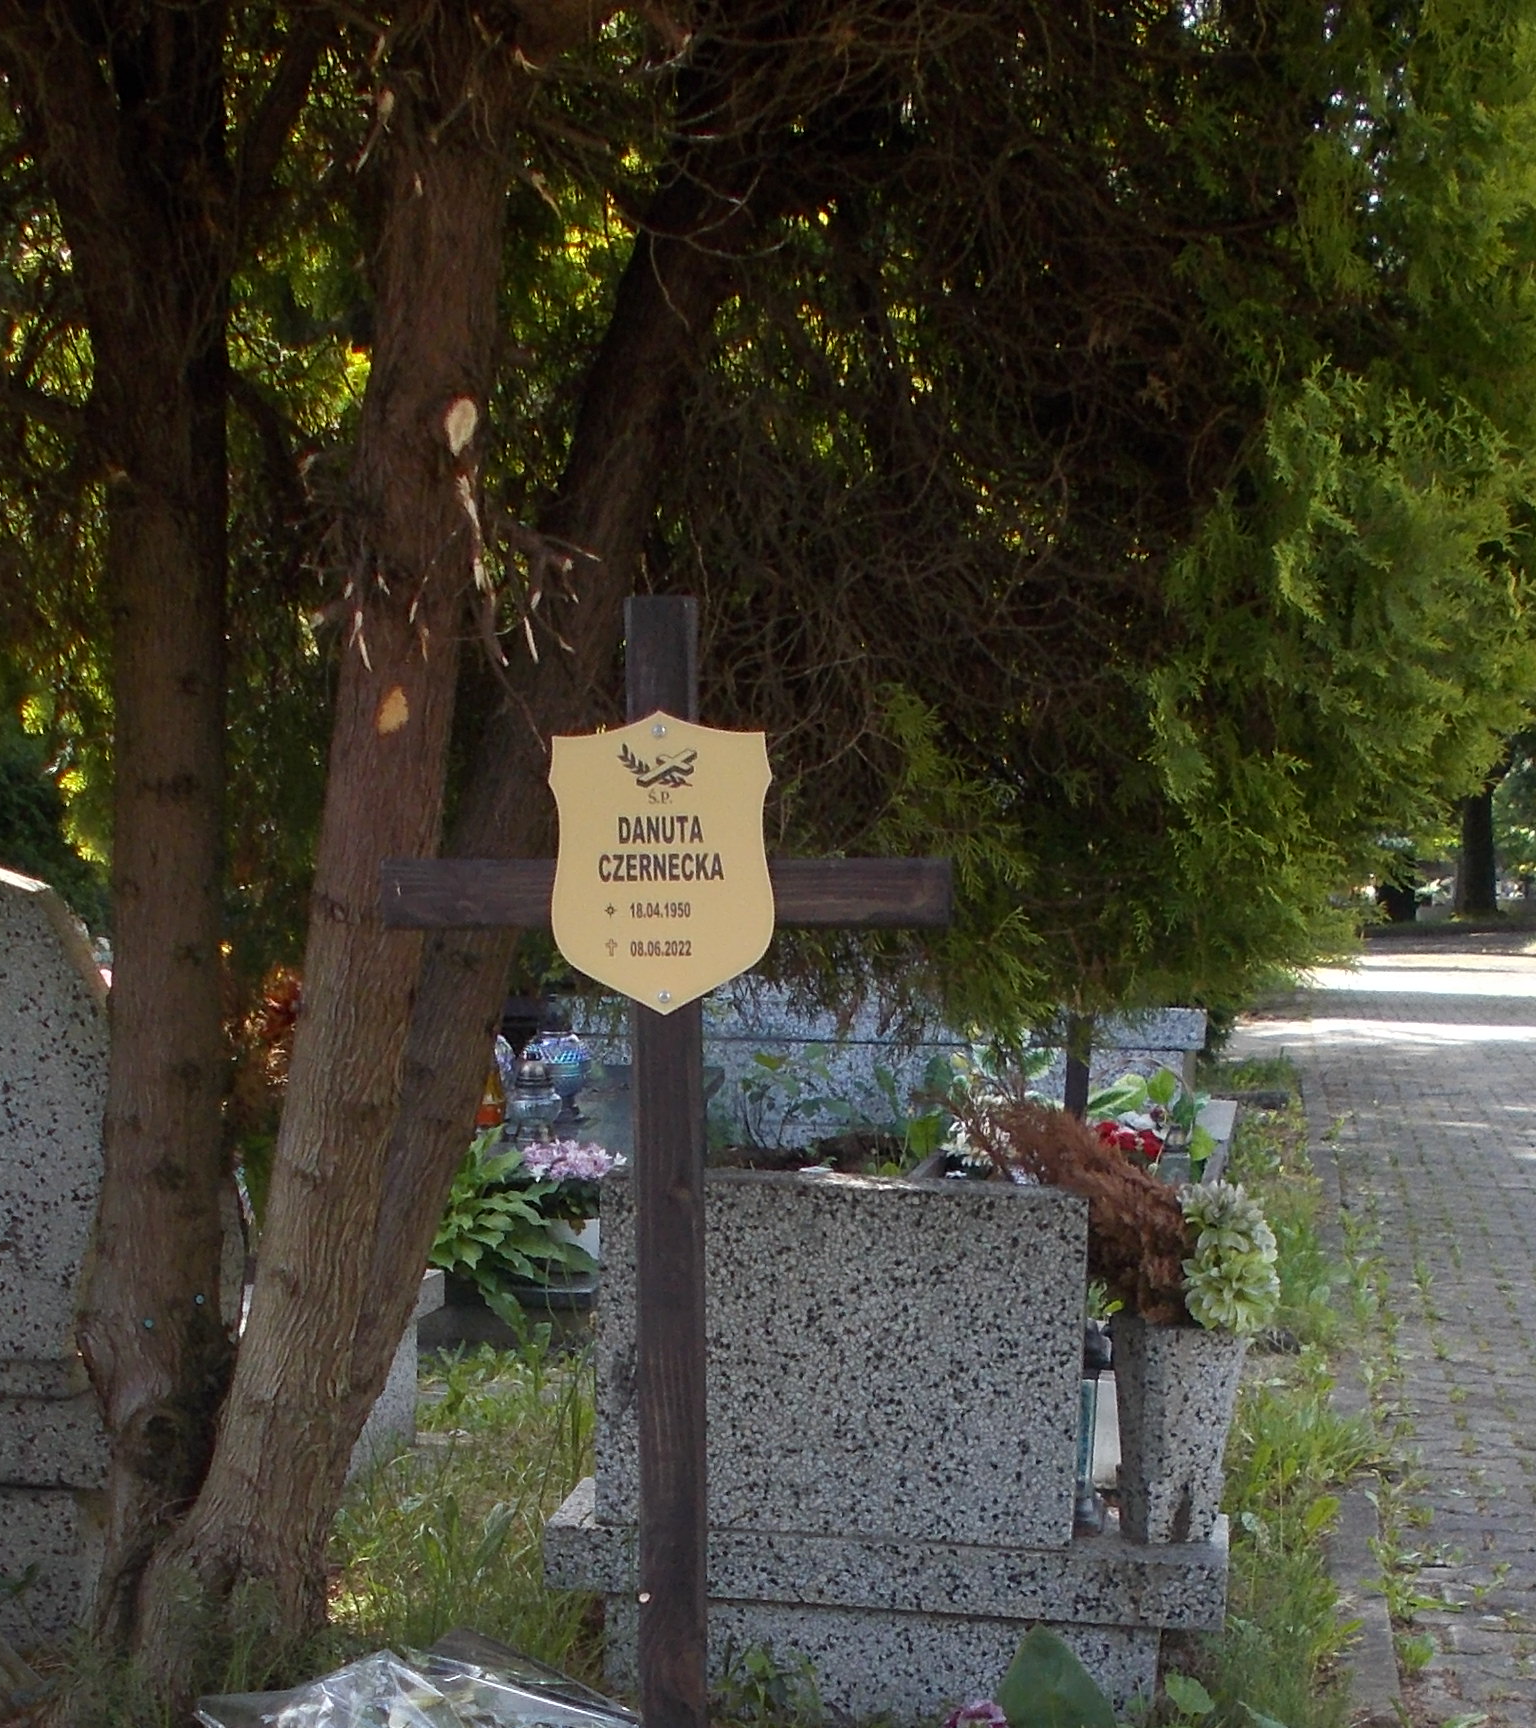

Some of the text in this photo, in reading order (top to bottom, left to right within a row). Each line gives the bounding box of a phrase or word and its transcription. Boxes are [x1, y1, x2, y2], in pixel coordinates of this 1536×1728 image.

[618, 815, 704, 844] DANUTA
[598, 854, 725, 882] CZERNECKA
[630, 902, 691, 919] 18.04.1950
[630, 940, 692, 957] 08.06.2022
